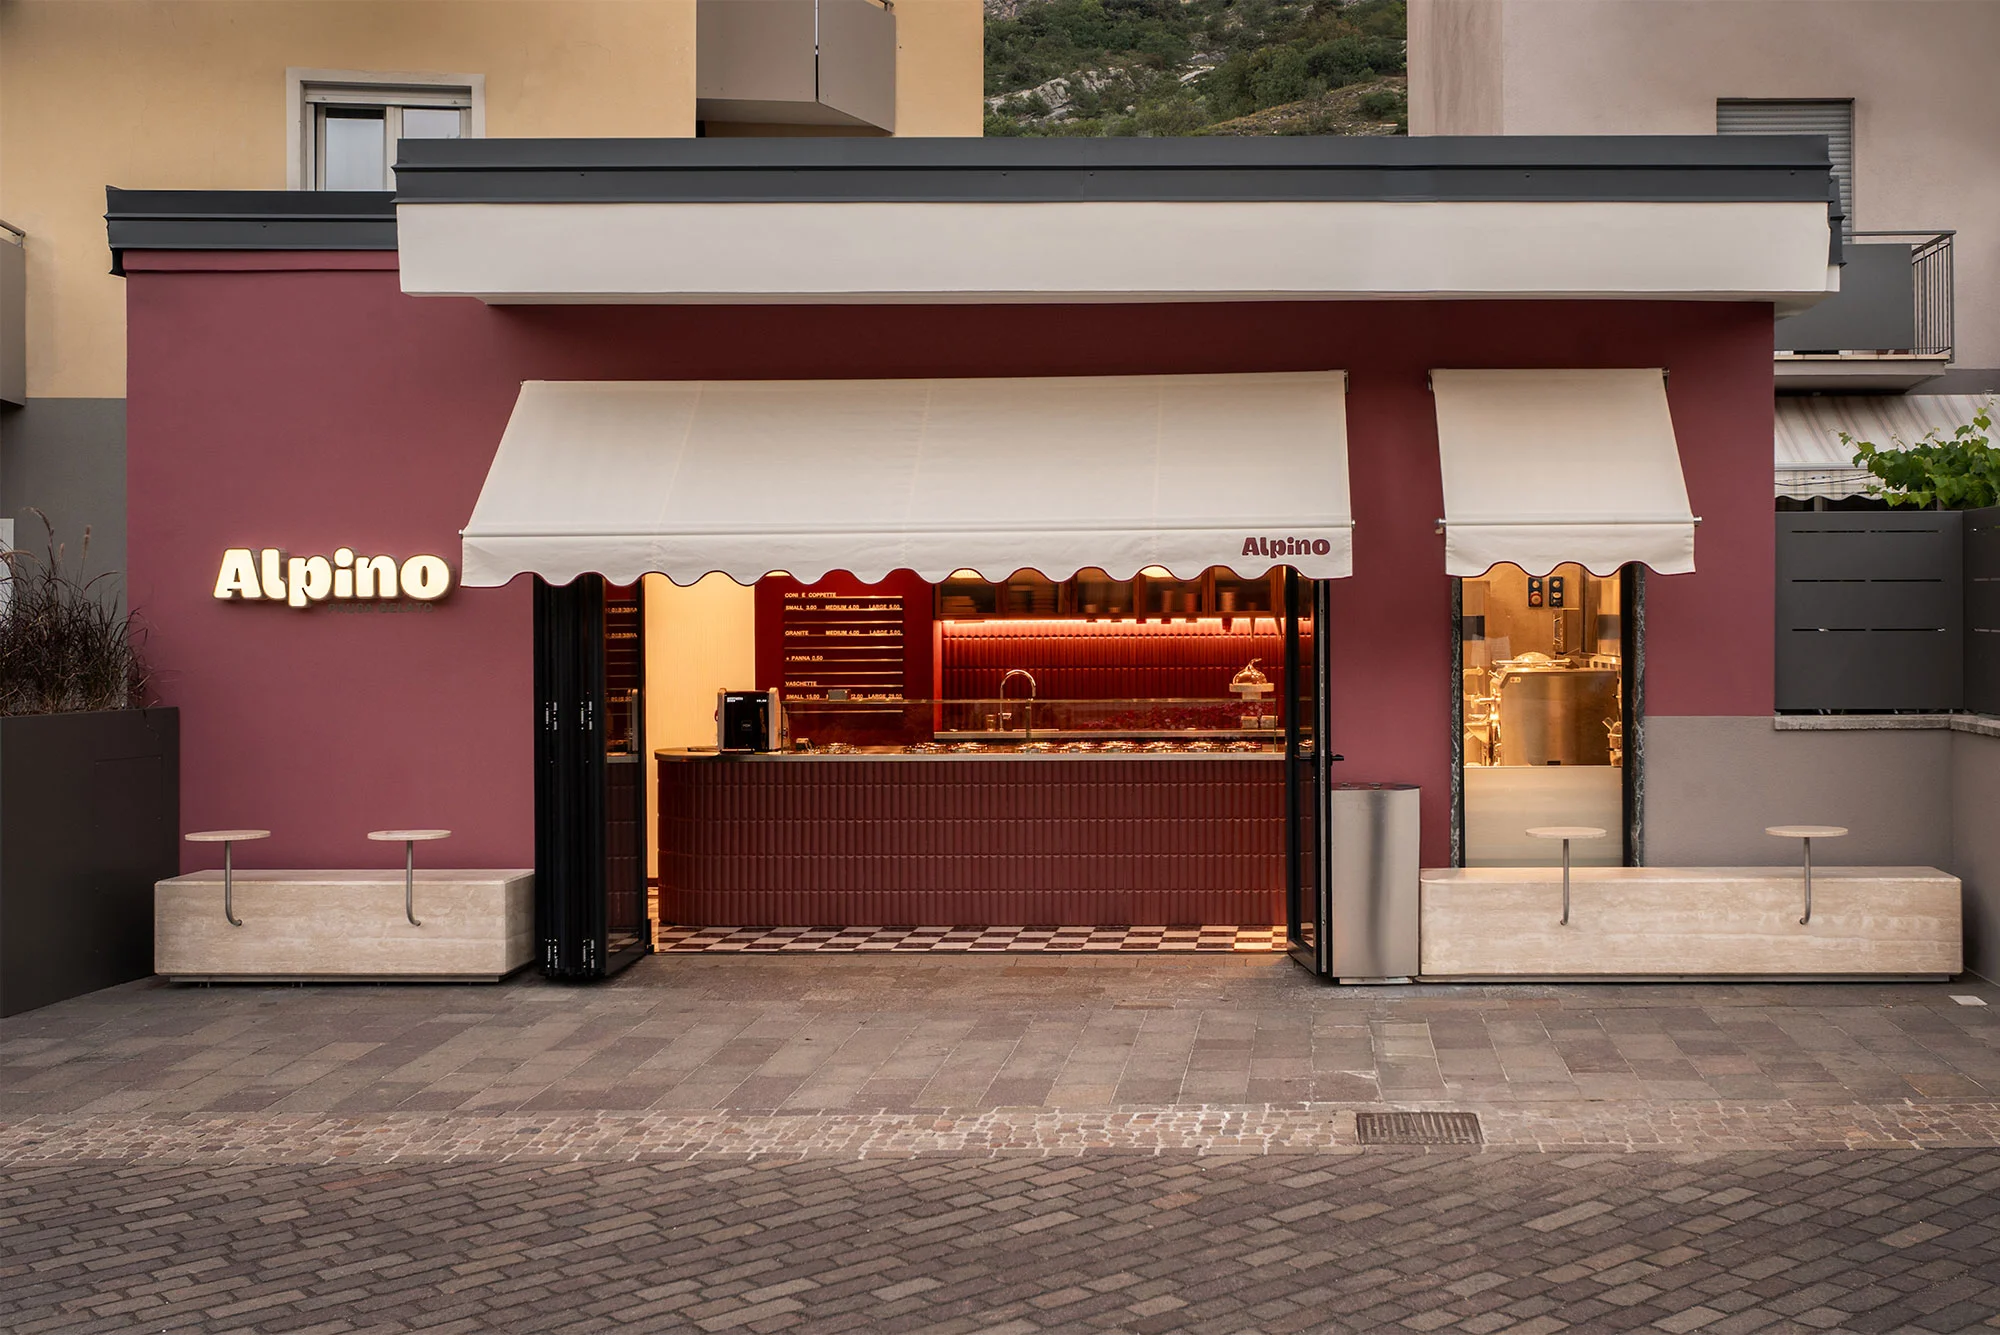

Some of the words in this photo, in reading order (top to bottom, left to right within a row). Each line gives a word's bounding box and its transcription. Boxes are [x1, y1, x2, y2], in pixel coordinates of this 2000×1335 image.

[1242, 536, 1331, 559] Alpino
[212, 547, 451, 608] Alpino
[327, 603, 374, 614] PAUSA
[377, 602, 433, 613] GELATO
